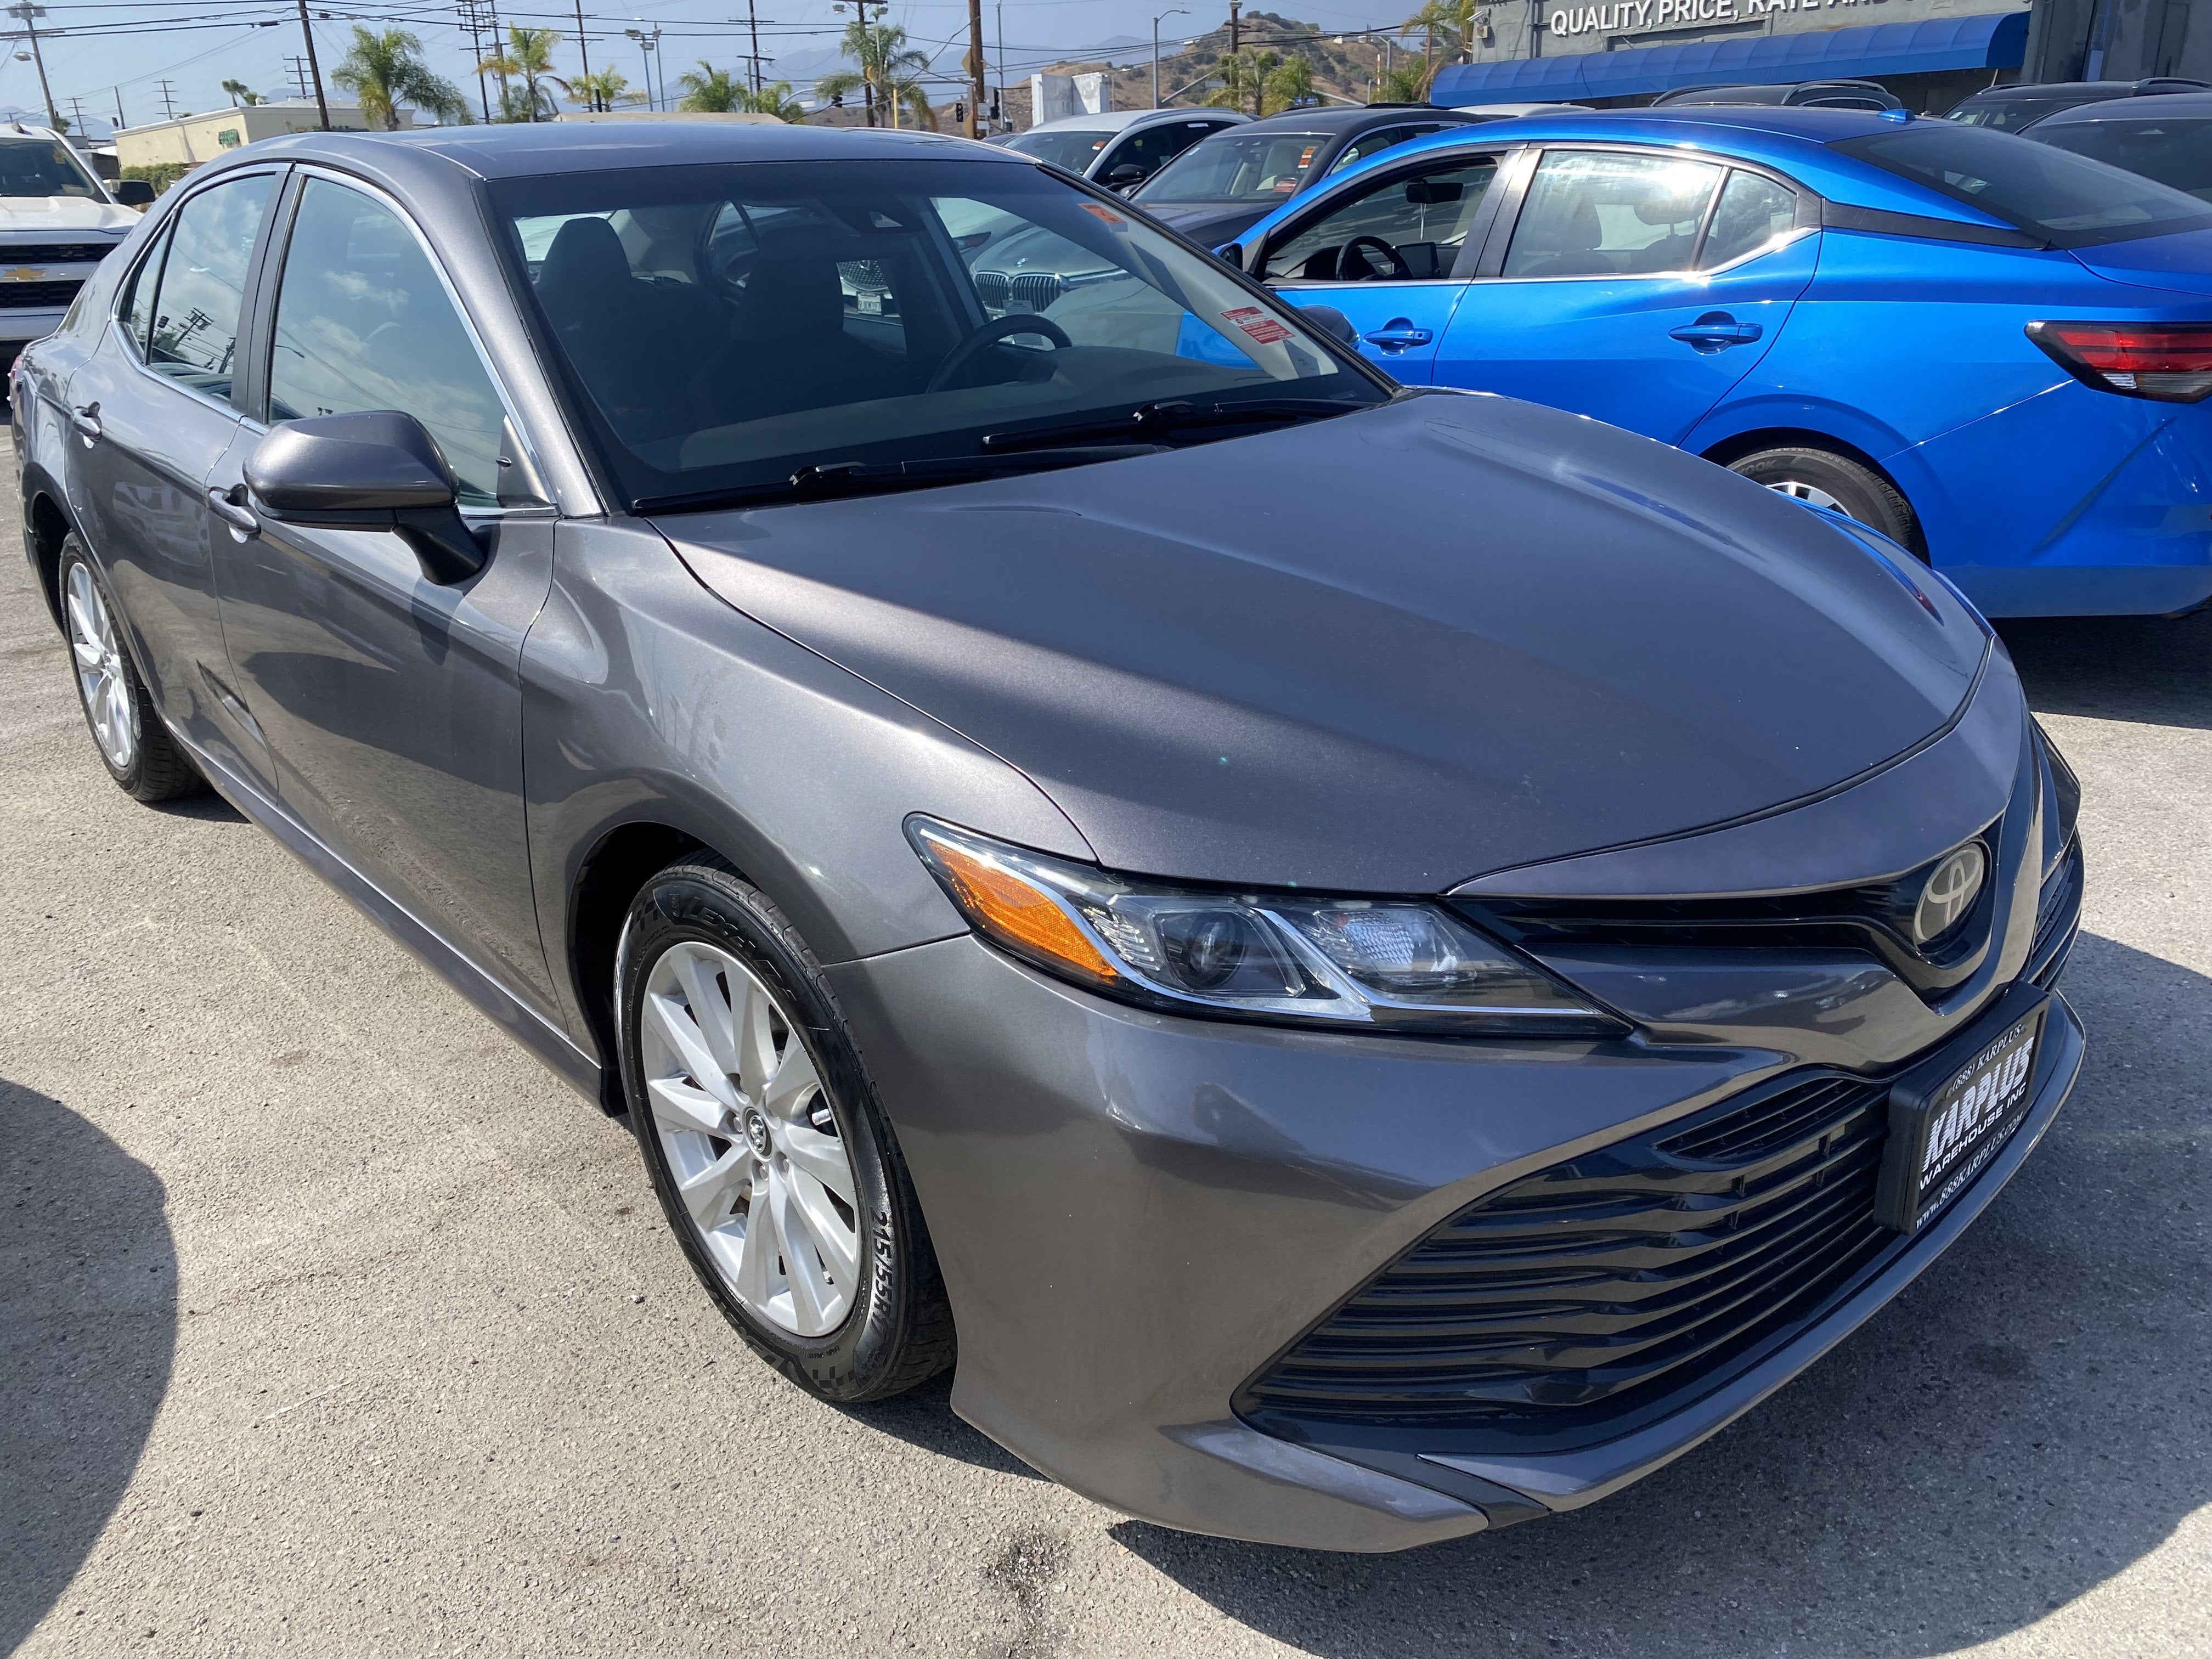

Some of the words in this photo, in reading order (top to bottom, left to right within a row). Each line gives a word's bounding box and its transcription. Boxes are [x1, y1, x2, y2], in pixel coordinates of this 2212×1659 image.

[1551, 1, 1653, 36] QUALITY,
[1658, 0, 1739, 23] PRICE,
[1922, 1036, 2034, 1172] KARPLUS
[1952, 1063, 1975, 1092] (888)
[1976, 1024, 2022, 1071] KARPLUS
[1920, 1104, 2004, 1190] WAREHOUSE
[2006, 1081, 2027, 1109] INC
[871, 1208, 894, 1341] 215/55R17
